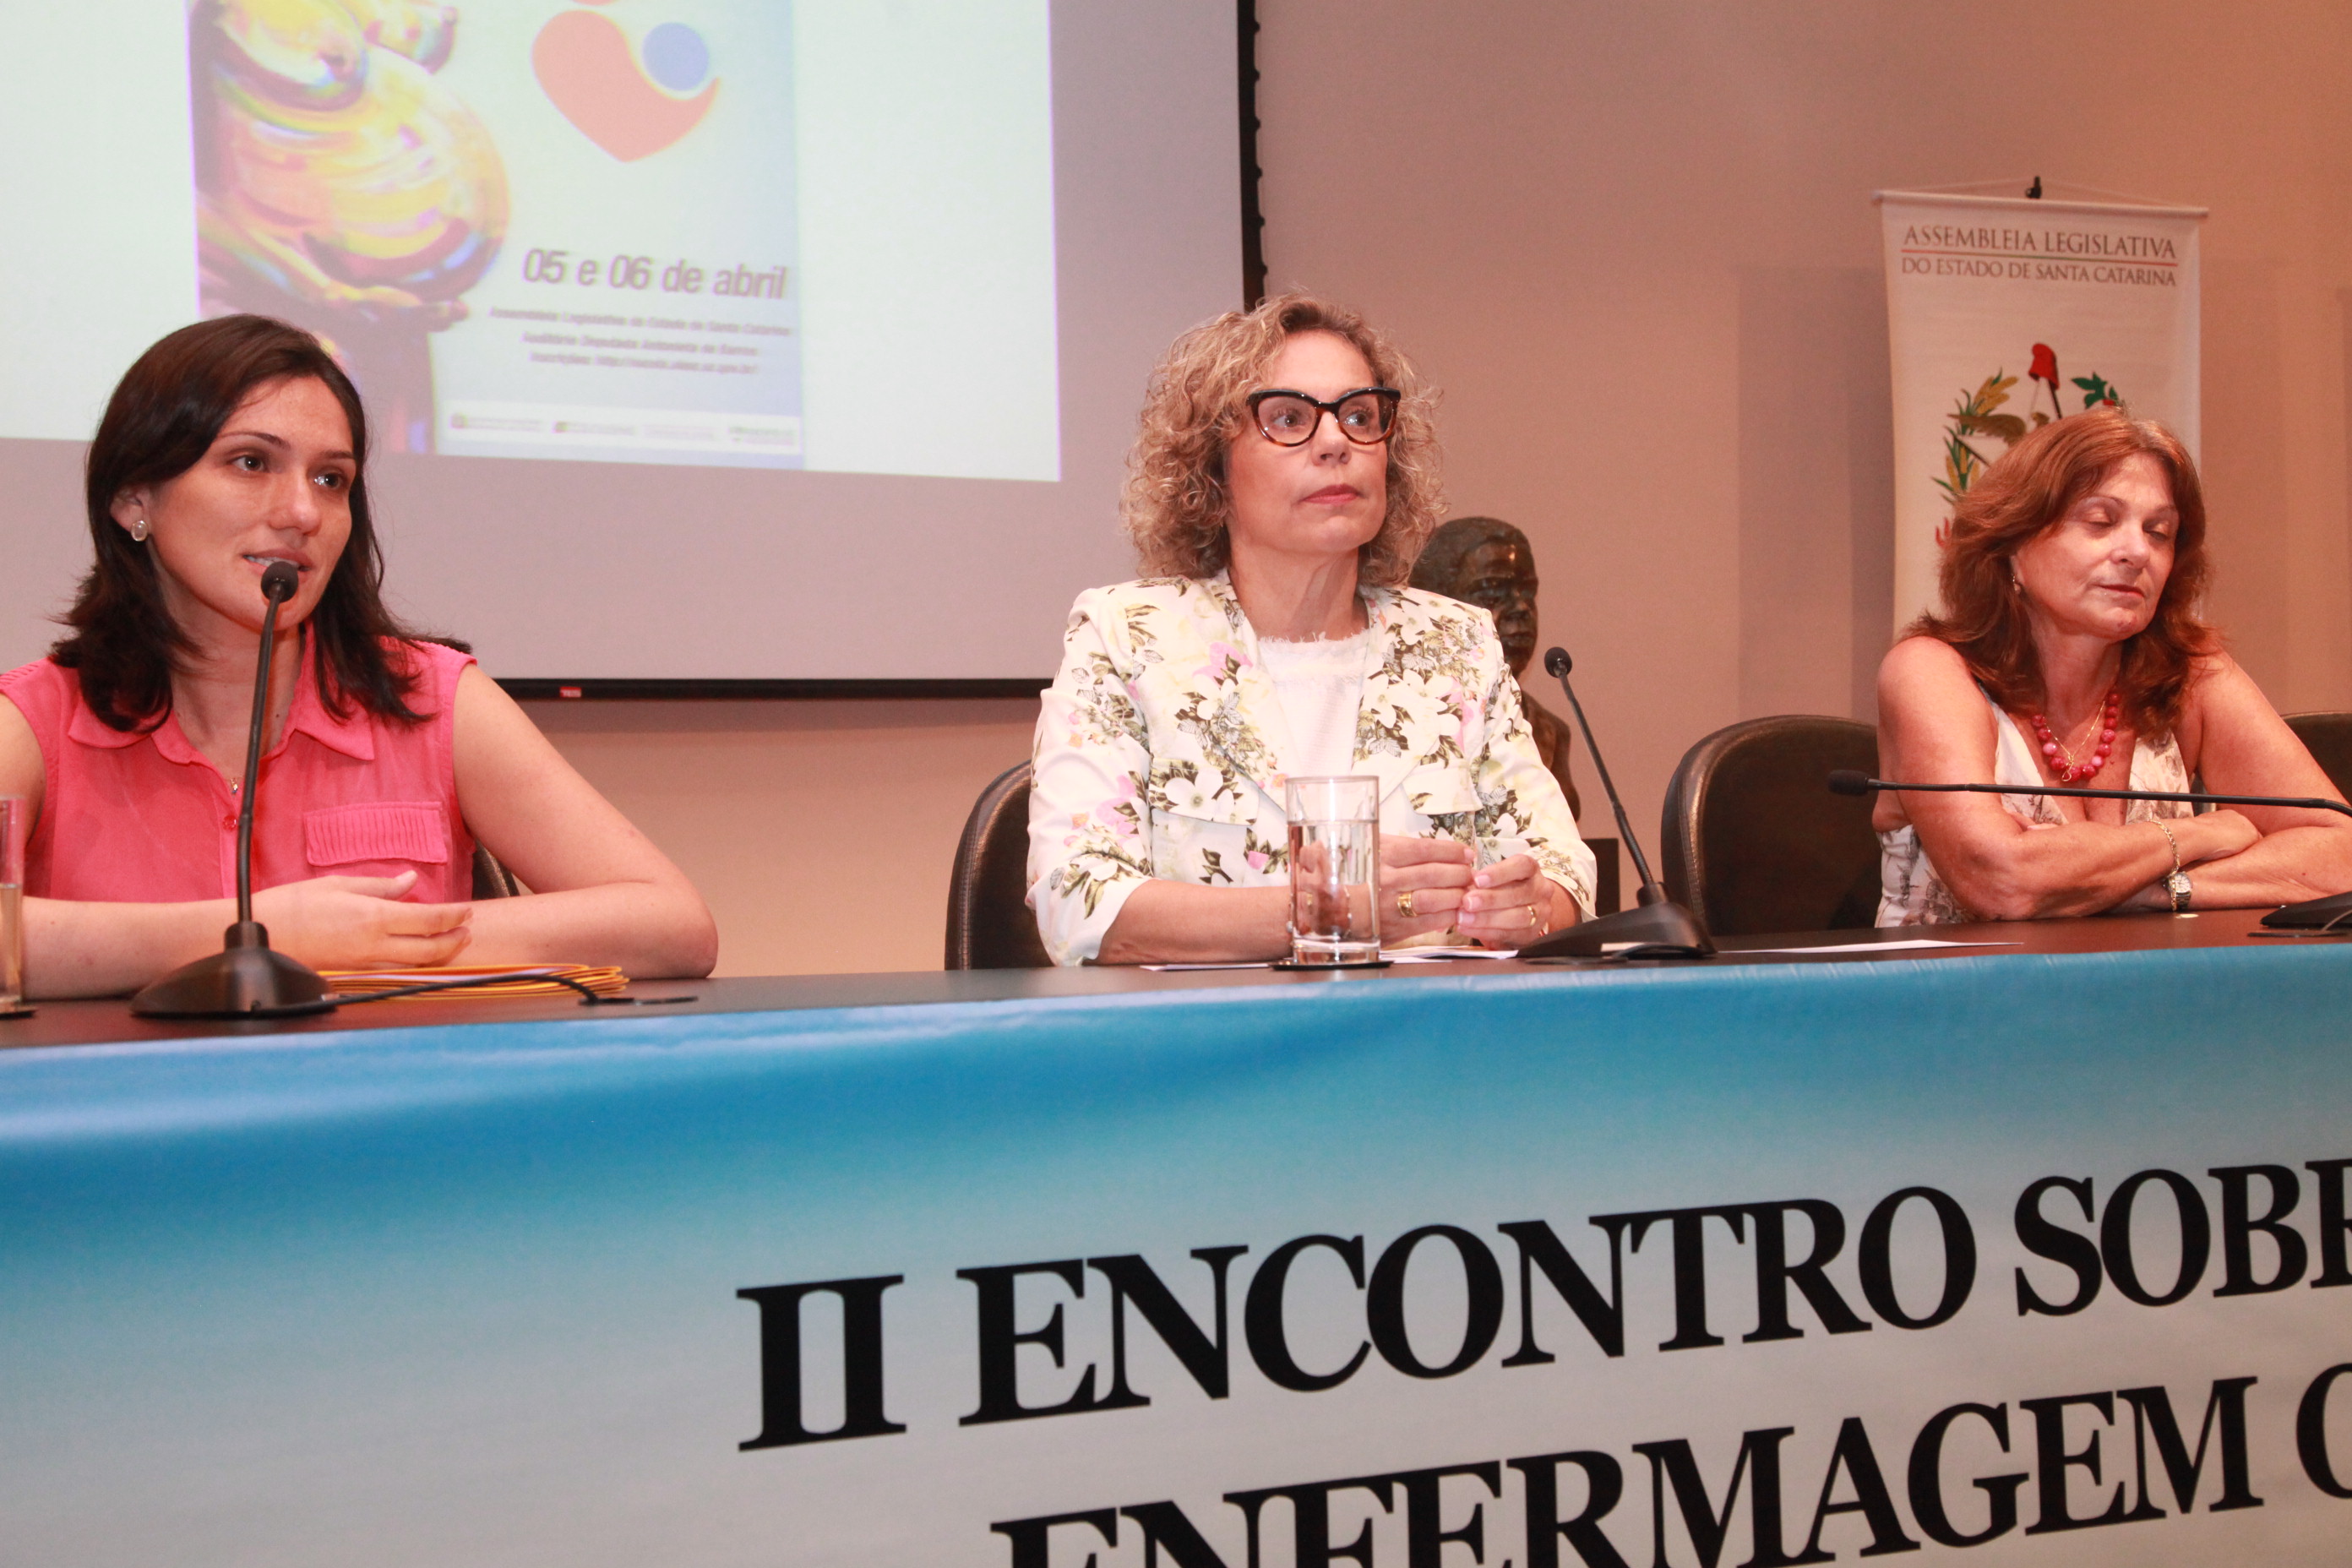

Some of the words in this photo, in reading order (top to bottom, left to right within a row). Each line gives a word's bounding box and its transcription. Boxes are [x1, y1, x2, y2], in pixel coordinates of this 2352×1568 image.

[1904, 225, 2037, 251] ASSEMBLEIA
[2044, 231, 2177, 259] LEGISLATIVA
[521, 248, 566, 284] 05
[575, 259, 596, 286] e
[607, 254, 651, 290] 06
[661, 259, 702, 293] de
[712, 264, 787, 299] abril
[1902, 257, 1931, 275] DO
[1936, 259, 2003, 278] ESTADO
[2008, 261, 2030, 280] DE
[2034, 263, 2090, 282] SANTA
[2093, 266, 2177, 287] CATARINA
[737, 1275, 907, 1451] II
[956, 1186, 1978, 1427] ENCONTRO
